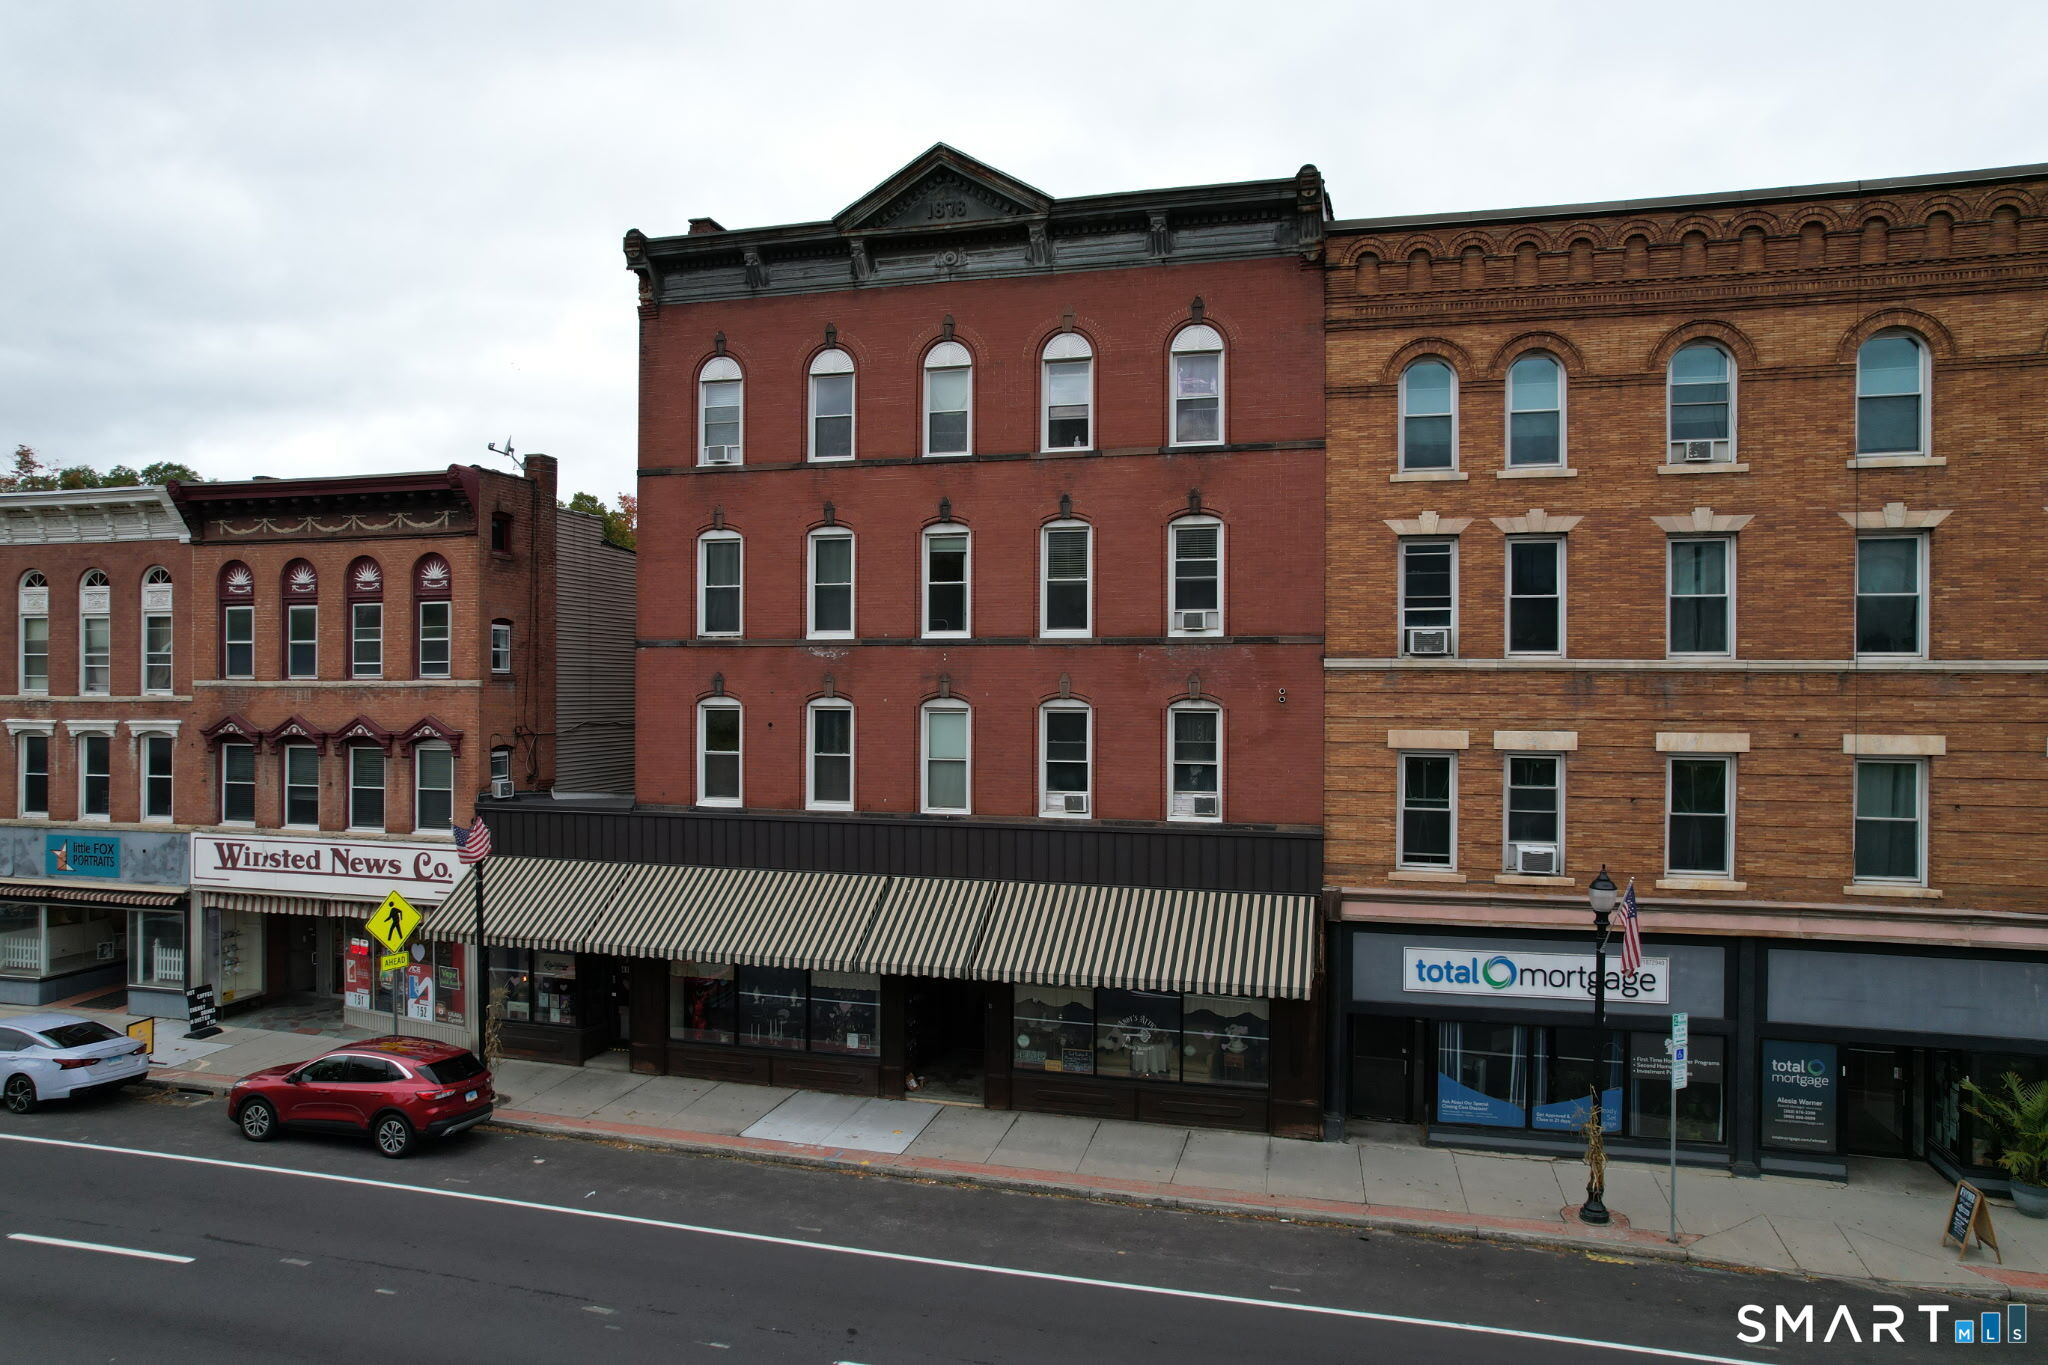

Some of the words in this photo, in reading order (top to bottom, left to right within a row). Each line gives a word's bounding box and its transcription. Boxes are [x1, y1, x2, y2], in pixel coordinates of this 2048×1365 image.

[74, 842, 91, 854] little
[94, 843, 115, 855] FOX
[74, 855, 115, 867] PORTRAITS
[214, 842, 321, 870] Winsted
[331, 848, 402, 875] News
[414, 852, 454, 879] Co.
[385, 956, 406, 968] AHEAD
[1416, 956, 1479, 985] total
[1694, 1059, 1720, 1067] Programs
[1772, 1059, 1805, 1073] total
[1772, 1074, 1829, 1088] mortgage
[1799, 1098, 1824, 1106] Warner
